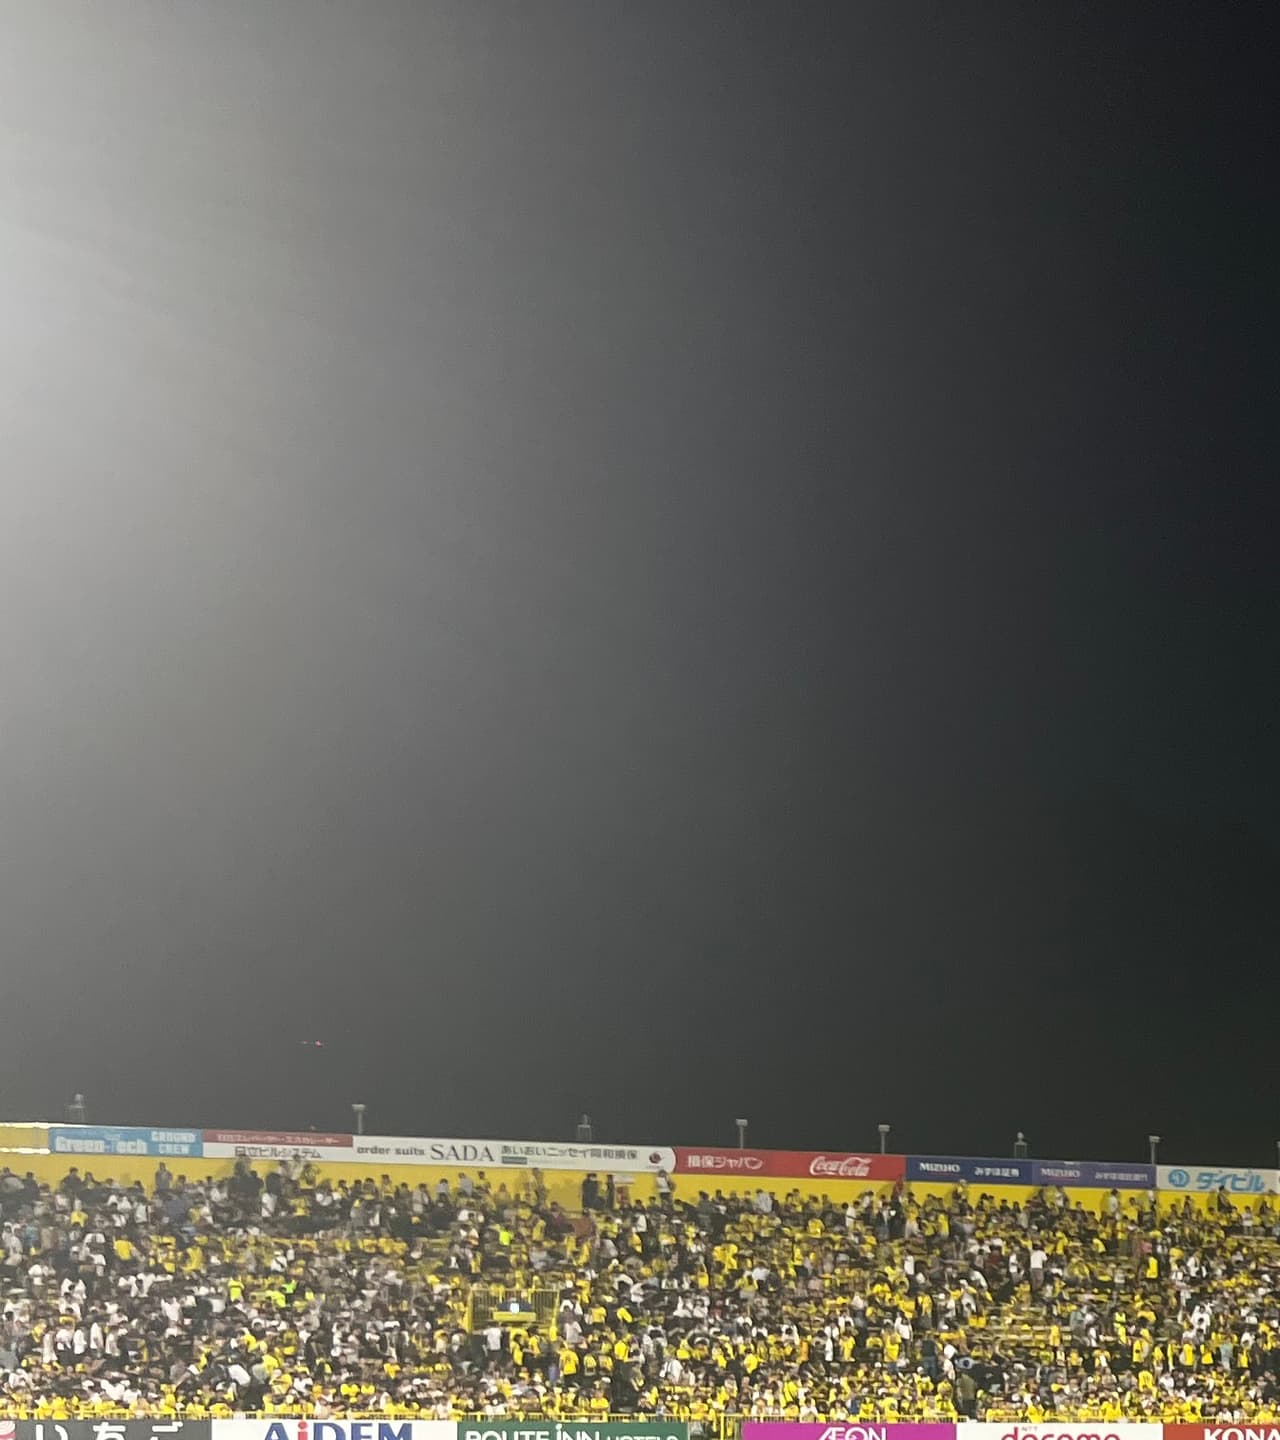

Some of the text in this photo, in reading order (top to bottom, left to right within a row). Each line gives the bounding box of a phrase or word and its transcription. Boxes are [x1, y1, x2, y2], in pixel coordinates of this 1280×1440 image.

[357, 1146, 390, 1155] order
[394, 1147, 425, 1156] suits
[430, 1143, 495, 1162] SADA
[919, 1162, 961, 1173] MIZUHO
[1041, 1167, 1081, 1178] MIZUHO
[1197, 1169, 1264, 1191] ダイビル
